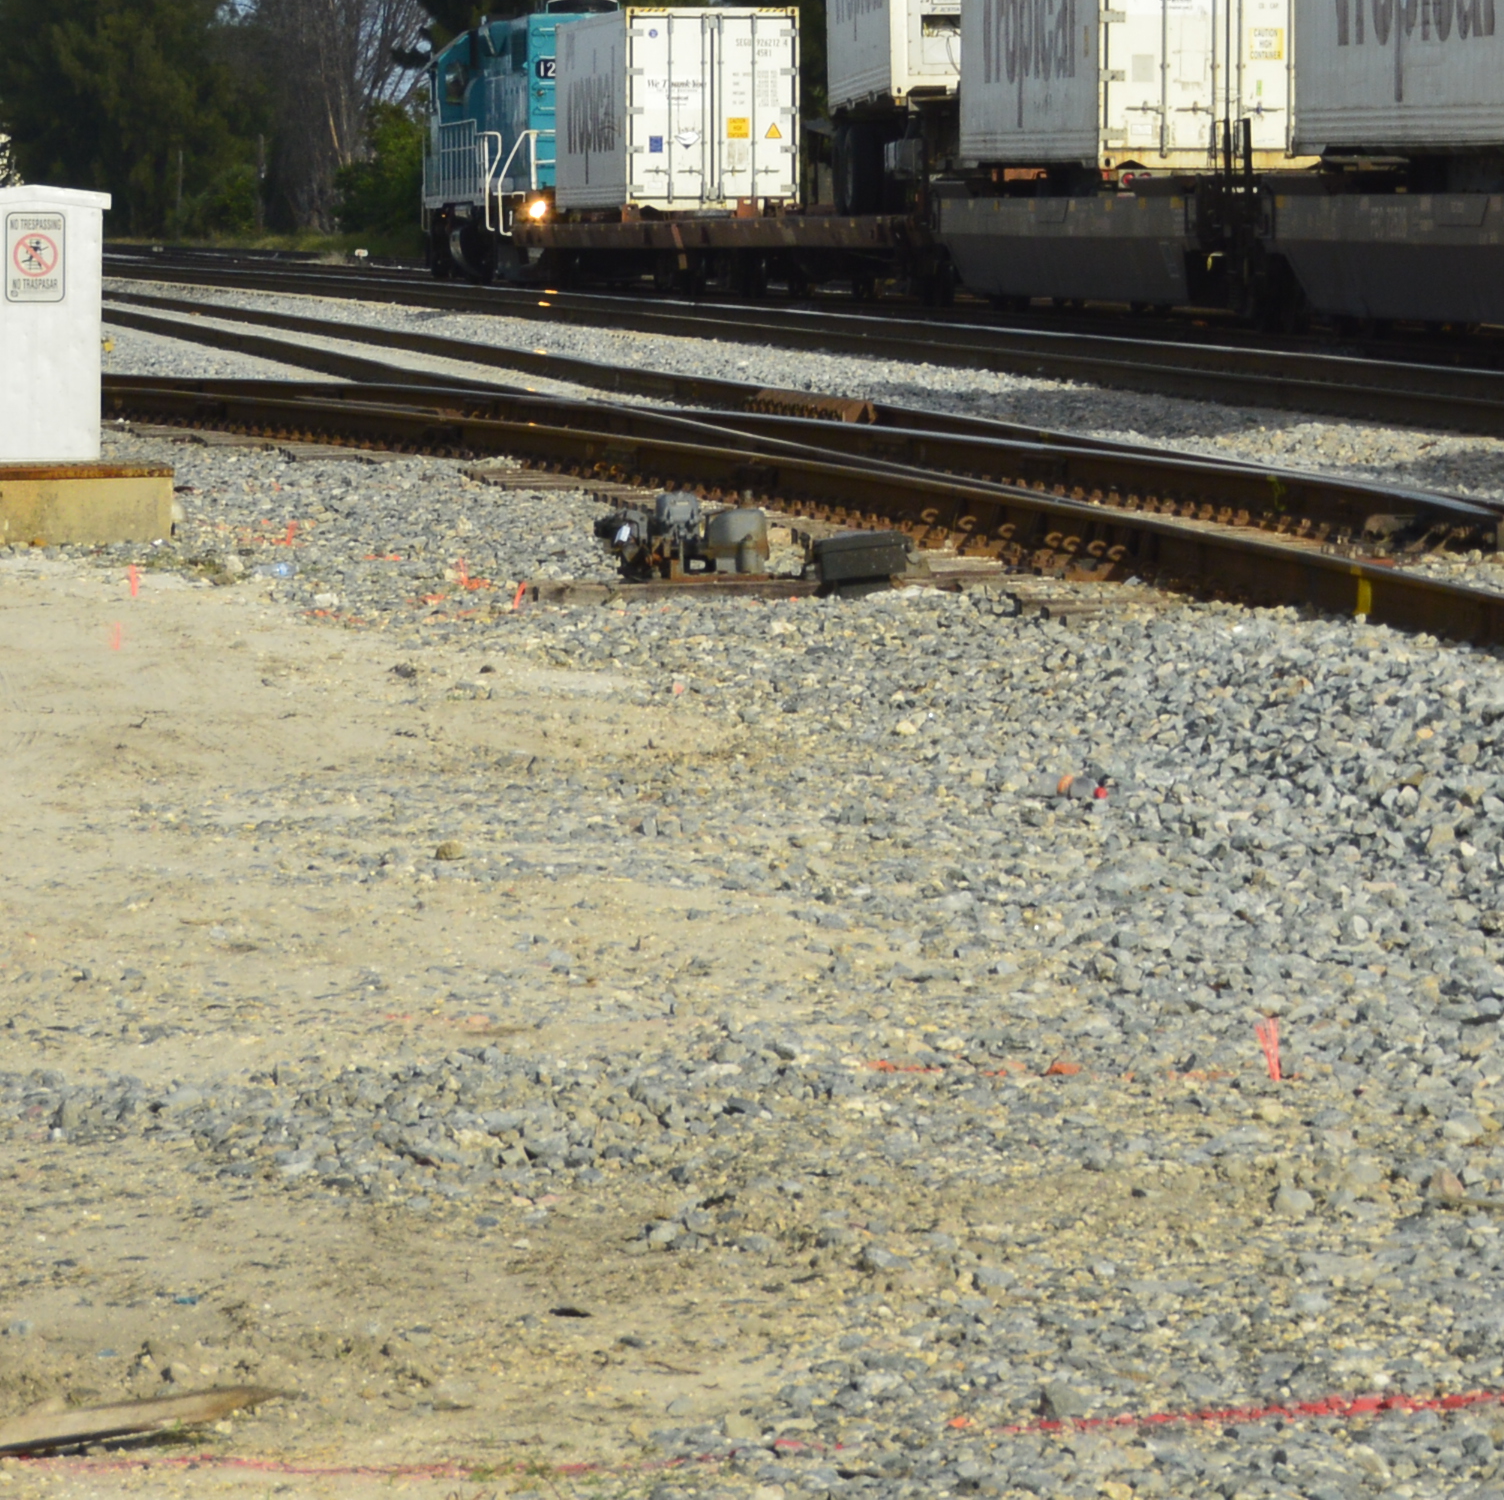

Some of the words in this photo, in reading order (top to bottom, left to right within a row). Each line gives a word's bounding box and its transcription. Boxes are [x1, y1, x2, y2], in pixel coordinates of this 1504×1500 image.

[565, 27, 615, 184] Tropical
[10, 218, 19, 230] NO
[20, 218, 61, 230] TRESPASSING
[12, 278, 21, 290] NO
[23, 278, 58, 290] TRASPASAR
